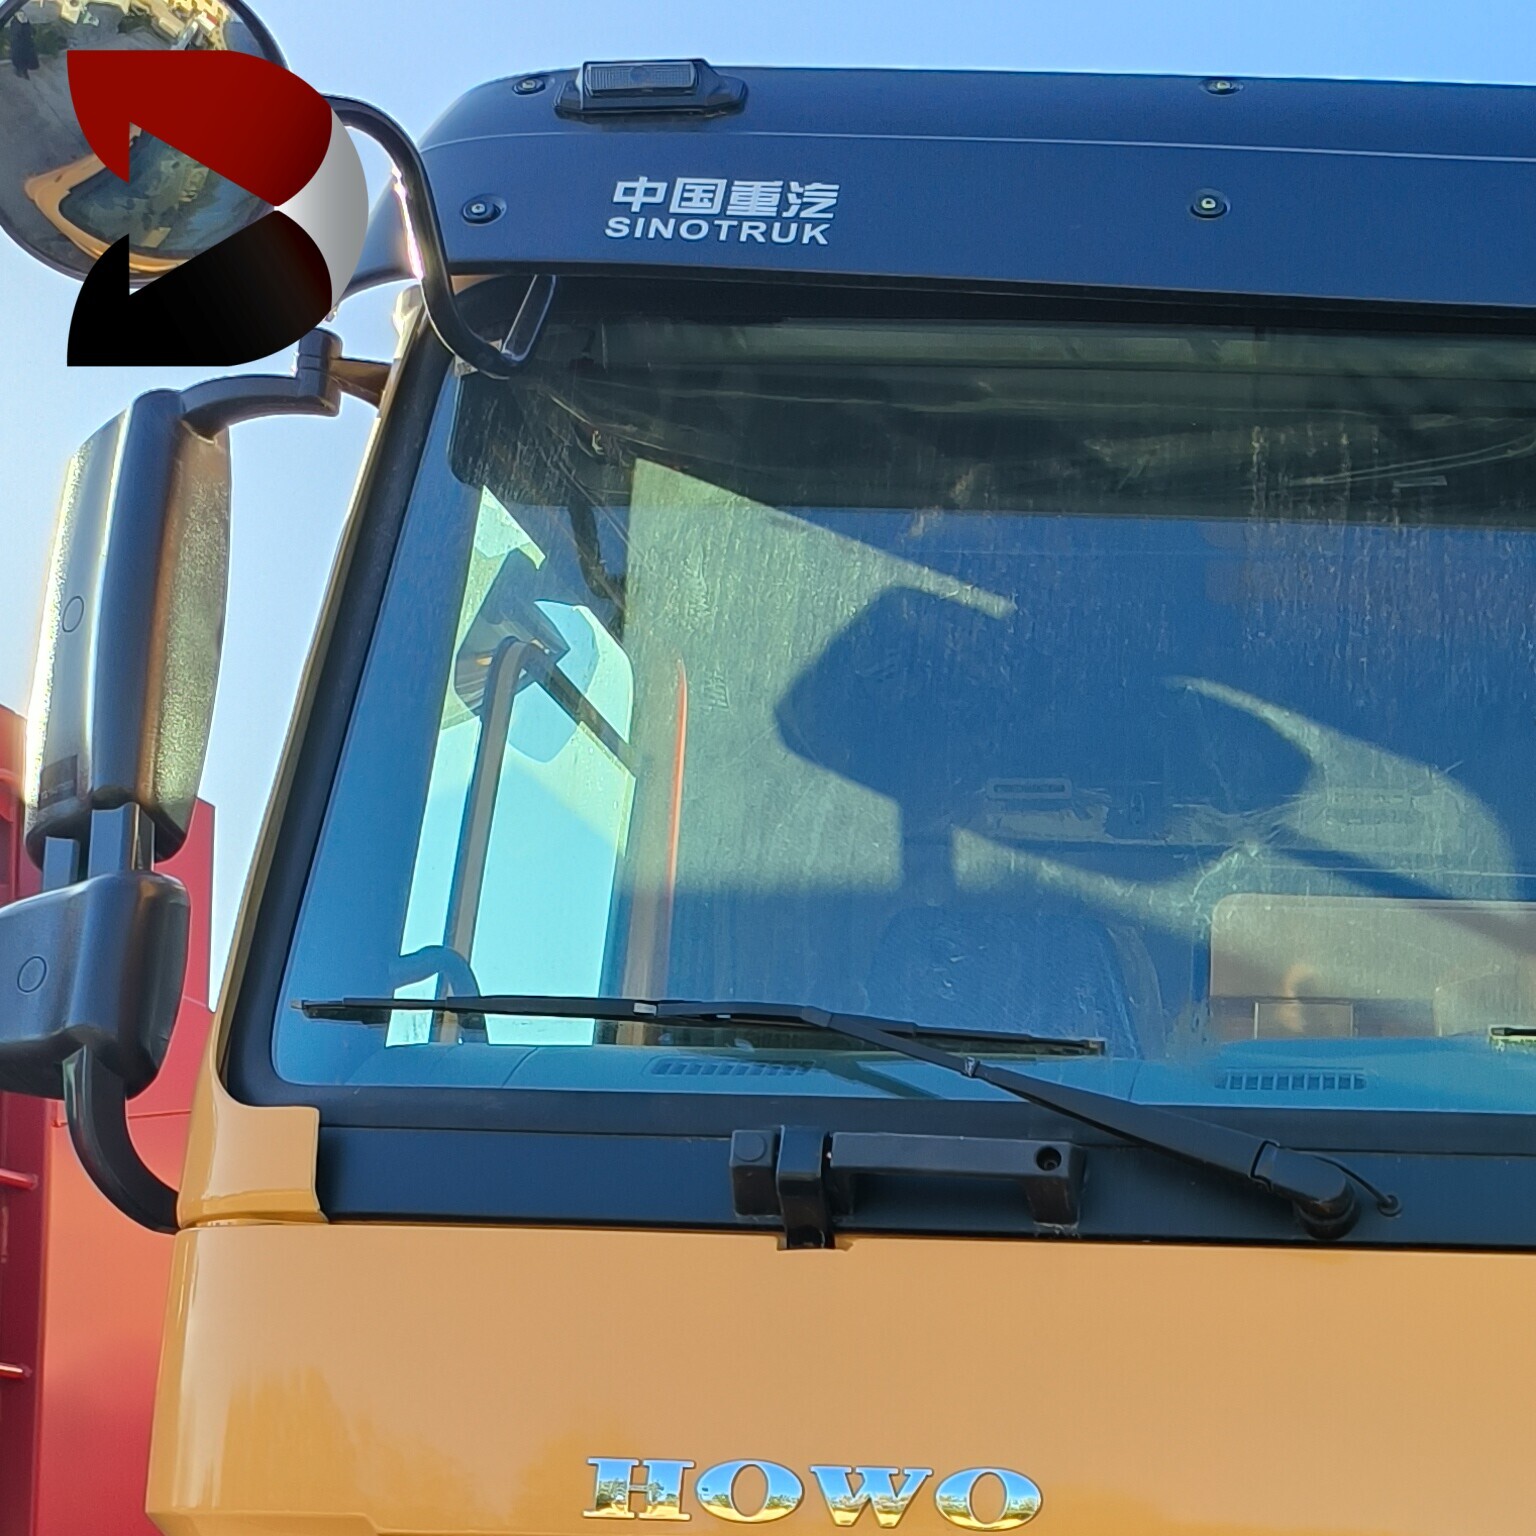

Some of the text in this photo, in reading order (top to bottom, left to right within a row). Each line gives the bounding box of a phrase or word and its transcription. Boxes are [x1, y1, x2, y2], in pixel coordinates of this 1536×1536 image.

[612, 176, 840, 219] 中国重汽
[604, 216, 831, 245] SINOTRUK
[582, 1456, 1043, 1532] HOWO
